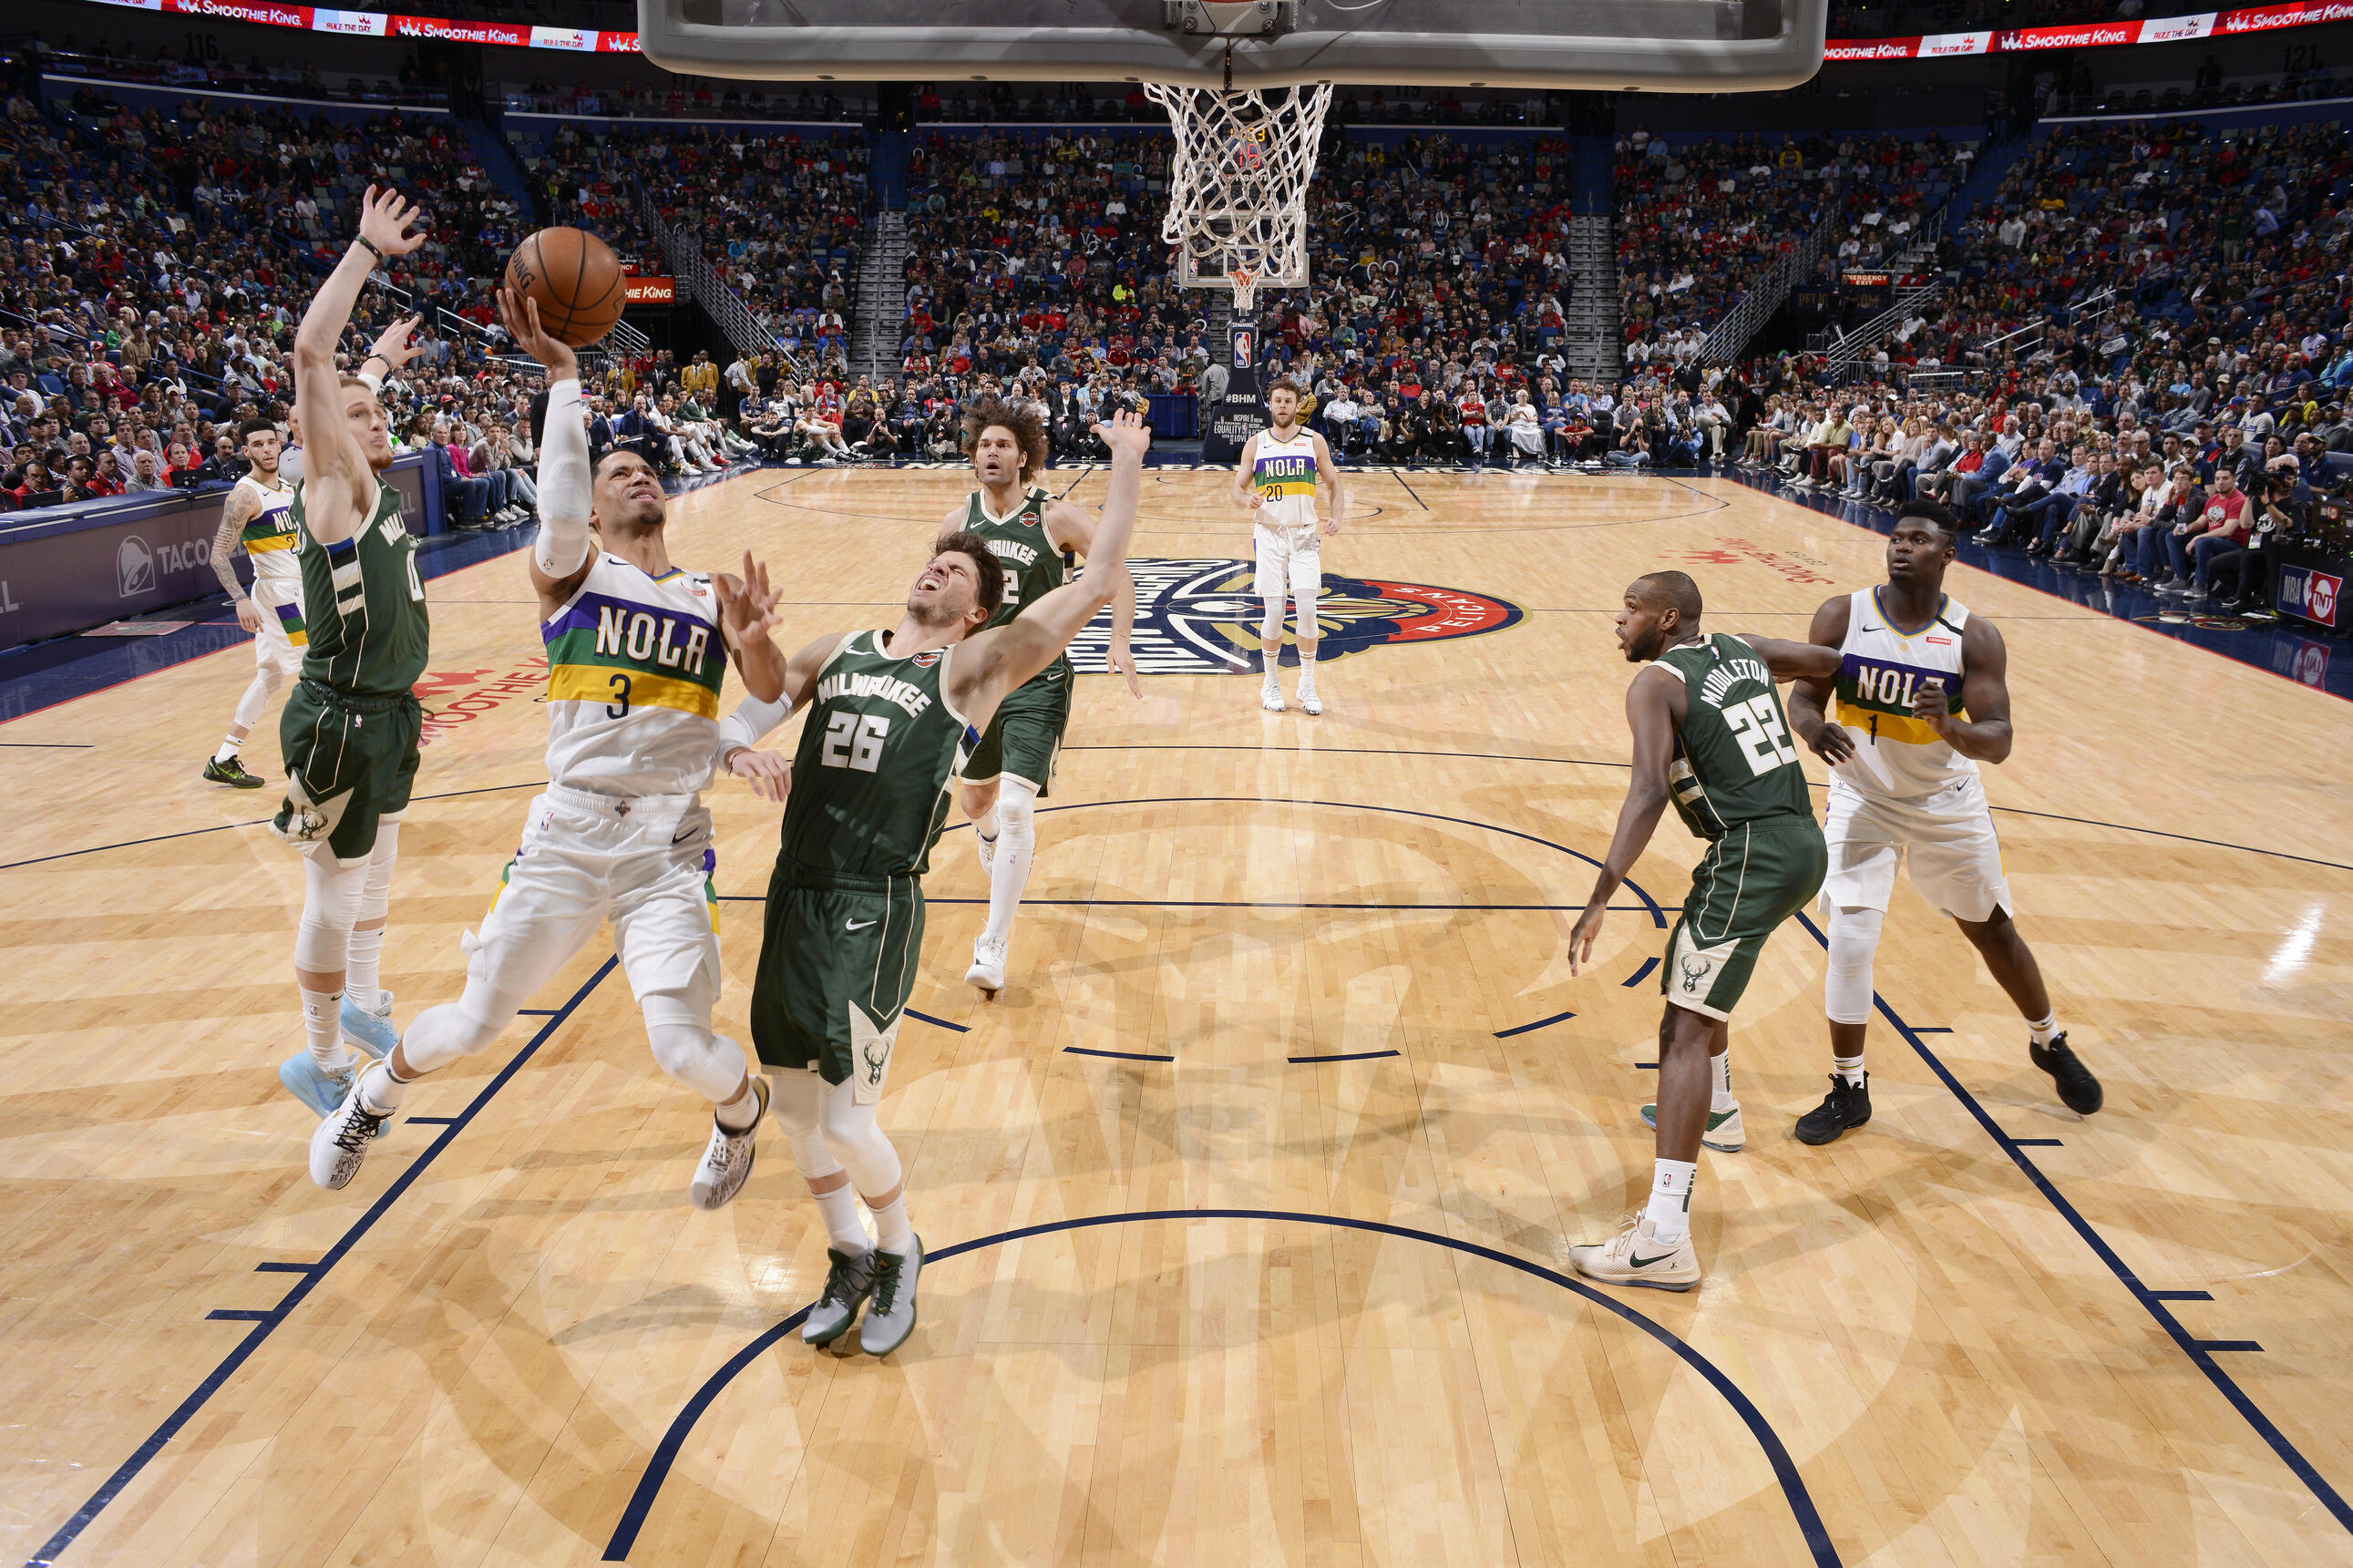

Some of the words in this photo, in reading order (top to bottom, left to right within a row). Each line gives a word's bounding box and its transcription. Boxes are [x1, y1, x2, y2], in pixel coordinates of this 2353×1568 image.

[202, 0, 268, 22] SMOOTHIE
[2251, 8, 2324, 30] SMOOTHIE
[423, 24, 487, 42] SMOOTHIE
[2024, 32, 2091, 49] SMOOTHIE
[1824, 46, 1876, 59] MOOTHIE
[1225, 394, 1257, 404] #BHM
[1214, 425, 1242, 435] EQUALITY
[1234, 434, 1248, 443] LOVE
[1264, 457, 1306, 478] NOLA
[1266, 485, 1283, 503] 20
[157, 538, 211, 575] TACO
[1002, 569, 1020, 605] 2
[2282, 575, 2302, 605] NBA
[1393, 587, 1486, 632] PELICANS
[2312, 591, 2334, 610] TNT
[593, 605, 711, 678] NOLA
[606, 673, 632, 720] 3
[817, 671, 932, 719] MILWAUKEE
[1700, 658, 1770, 710] MIDDLETON
[821, 710, 891, 774] 26
[1721, 692, 1800, 777] 22
[1868, 713, 1878, 746] 1
